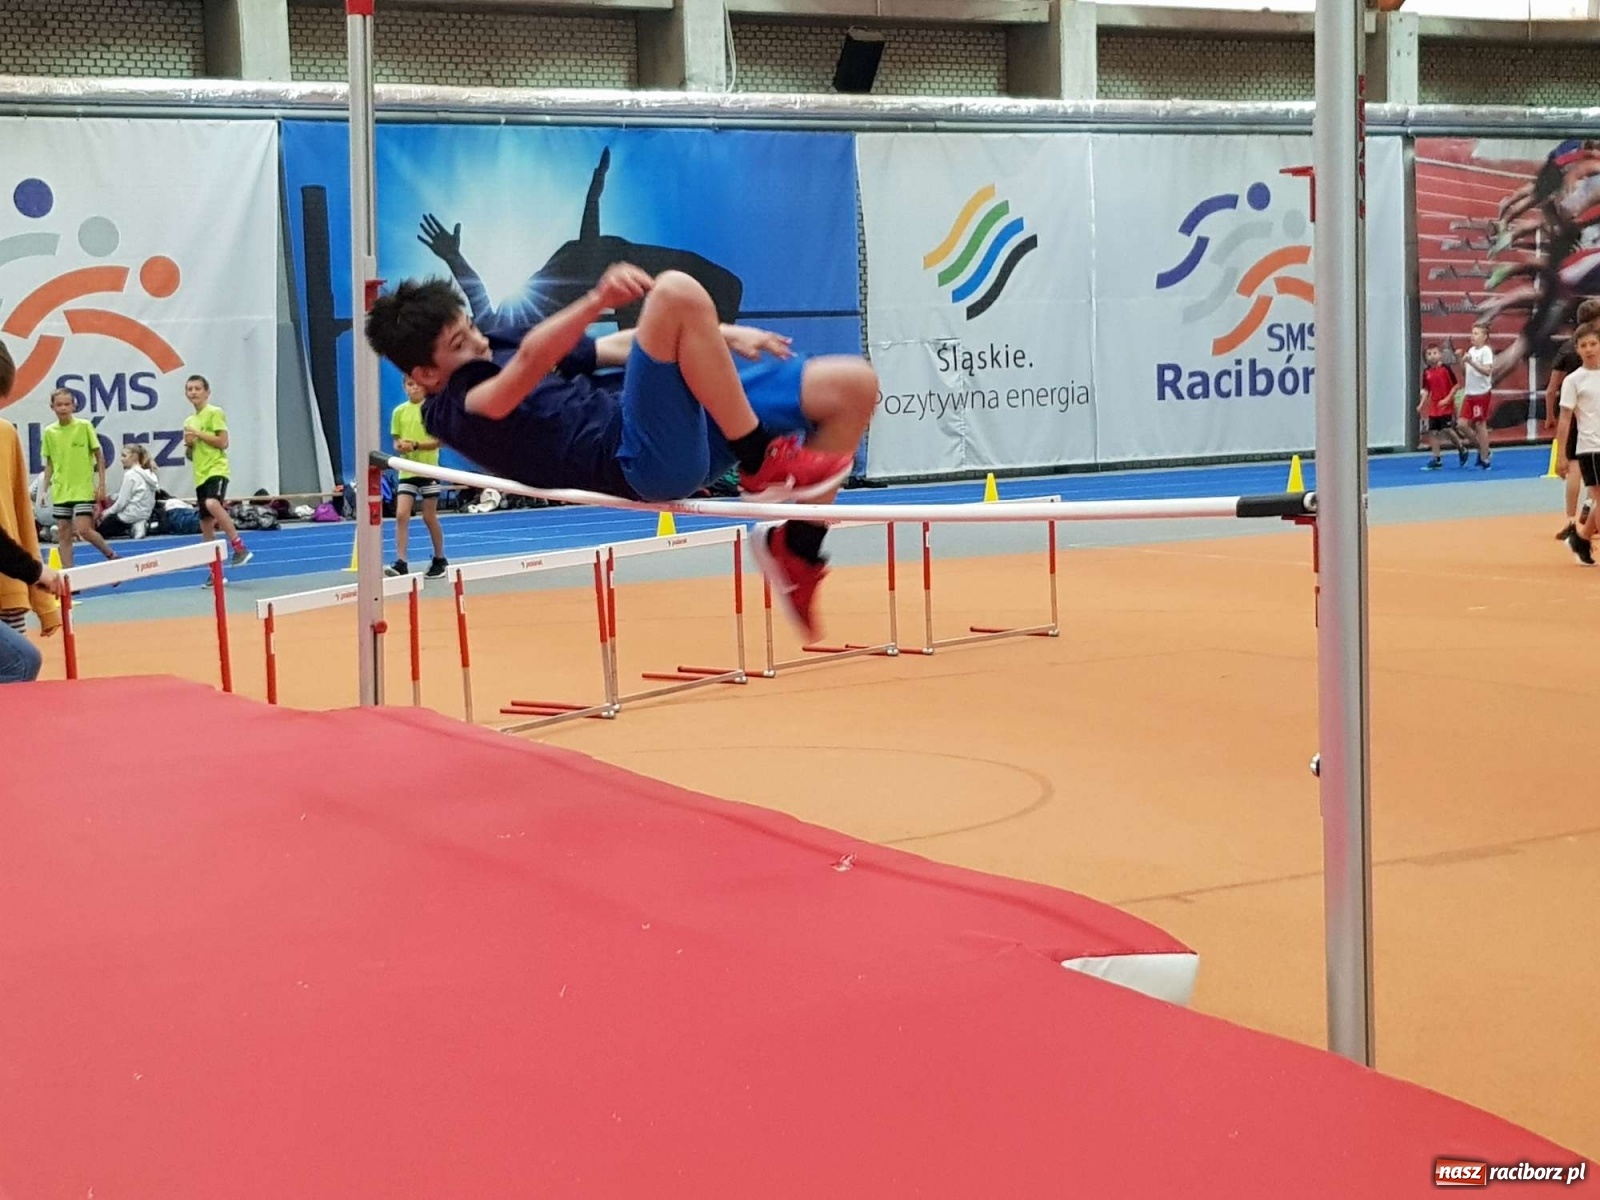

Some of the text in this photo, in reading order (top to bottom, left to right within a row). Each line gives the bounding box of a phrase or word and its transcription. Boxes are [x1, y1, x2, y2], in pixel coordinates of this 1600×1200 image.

[937, 343, 1034, 376] Śląskie.
[1156, 352, 1315, 401] Racibór
[56, 371, 159, 413] SMS
[1006, 380, 1089, 413] energia
